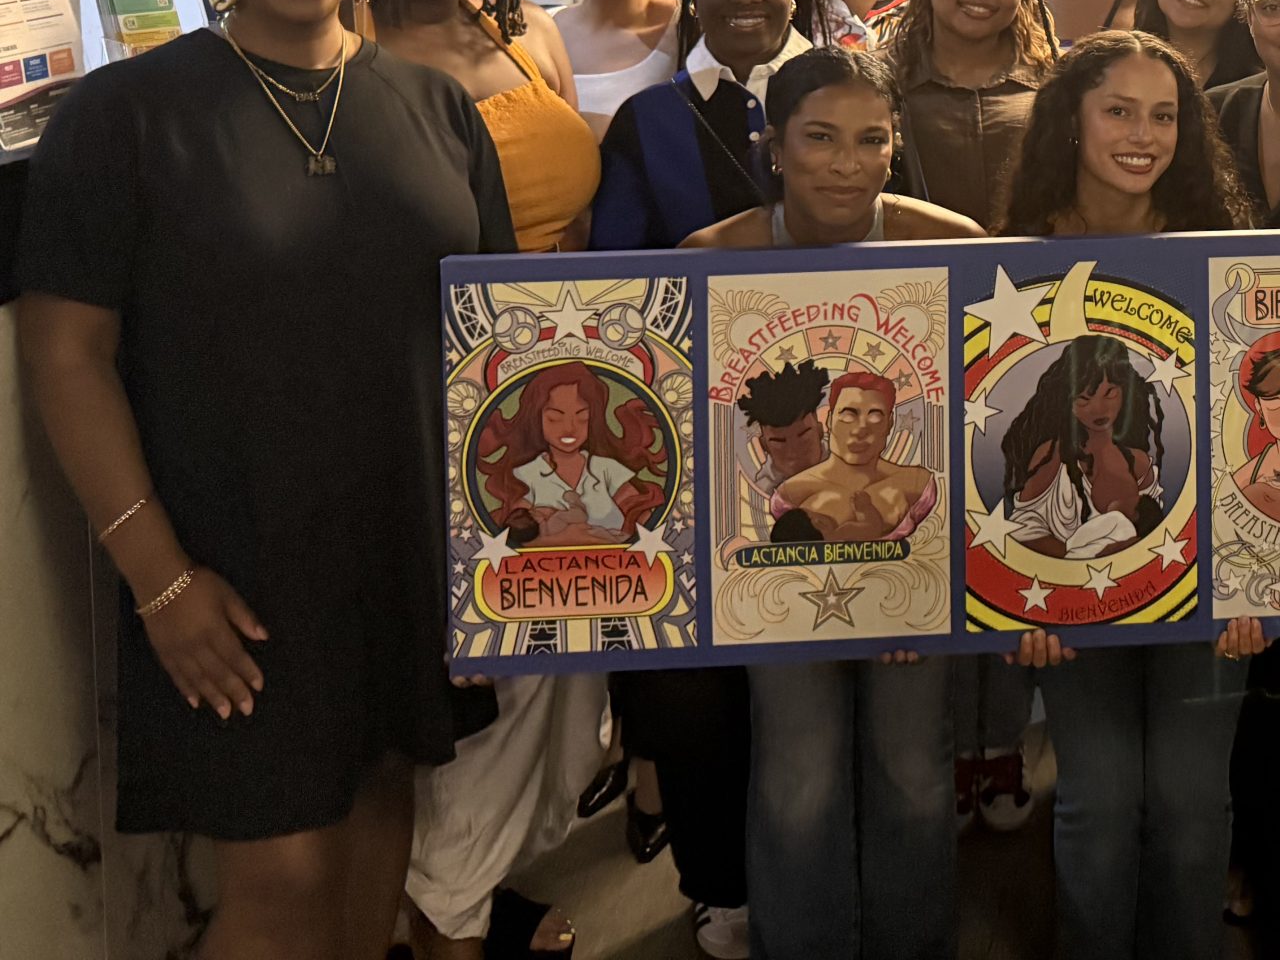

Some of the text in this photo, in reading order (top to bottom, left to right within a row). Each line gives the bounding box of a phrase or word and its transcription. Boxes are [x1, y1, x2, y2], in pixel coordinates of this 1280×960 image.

[1093, 288, 1194, 344] WELCOME
[585, 344, 636, 369] WELCOME
[849, 292, 945, 403] WELCOME
[505, 554, 641, 575] LACTANCIA
[742, 541, 904, 567] LACTANCIA BIENVENIDA
[500, 574, 649, 611] BIENVENIDA
[1059, 580, 1157, 621] BIENVENIDA
